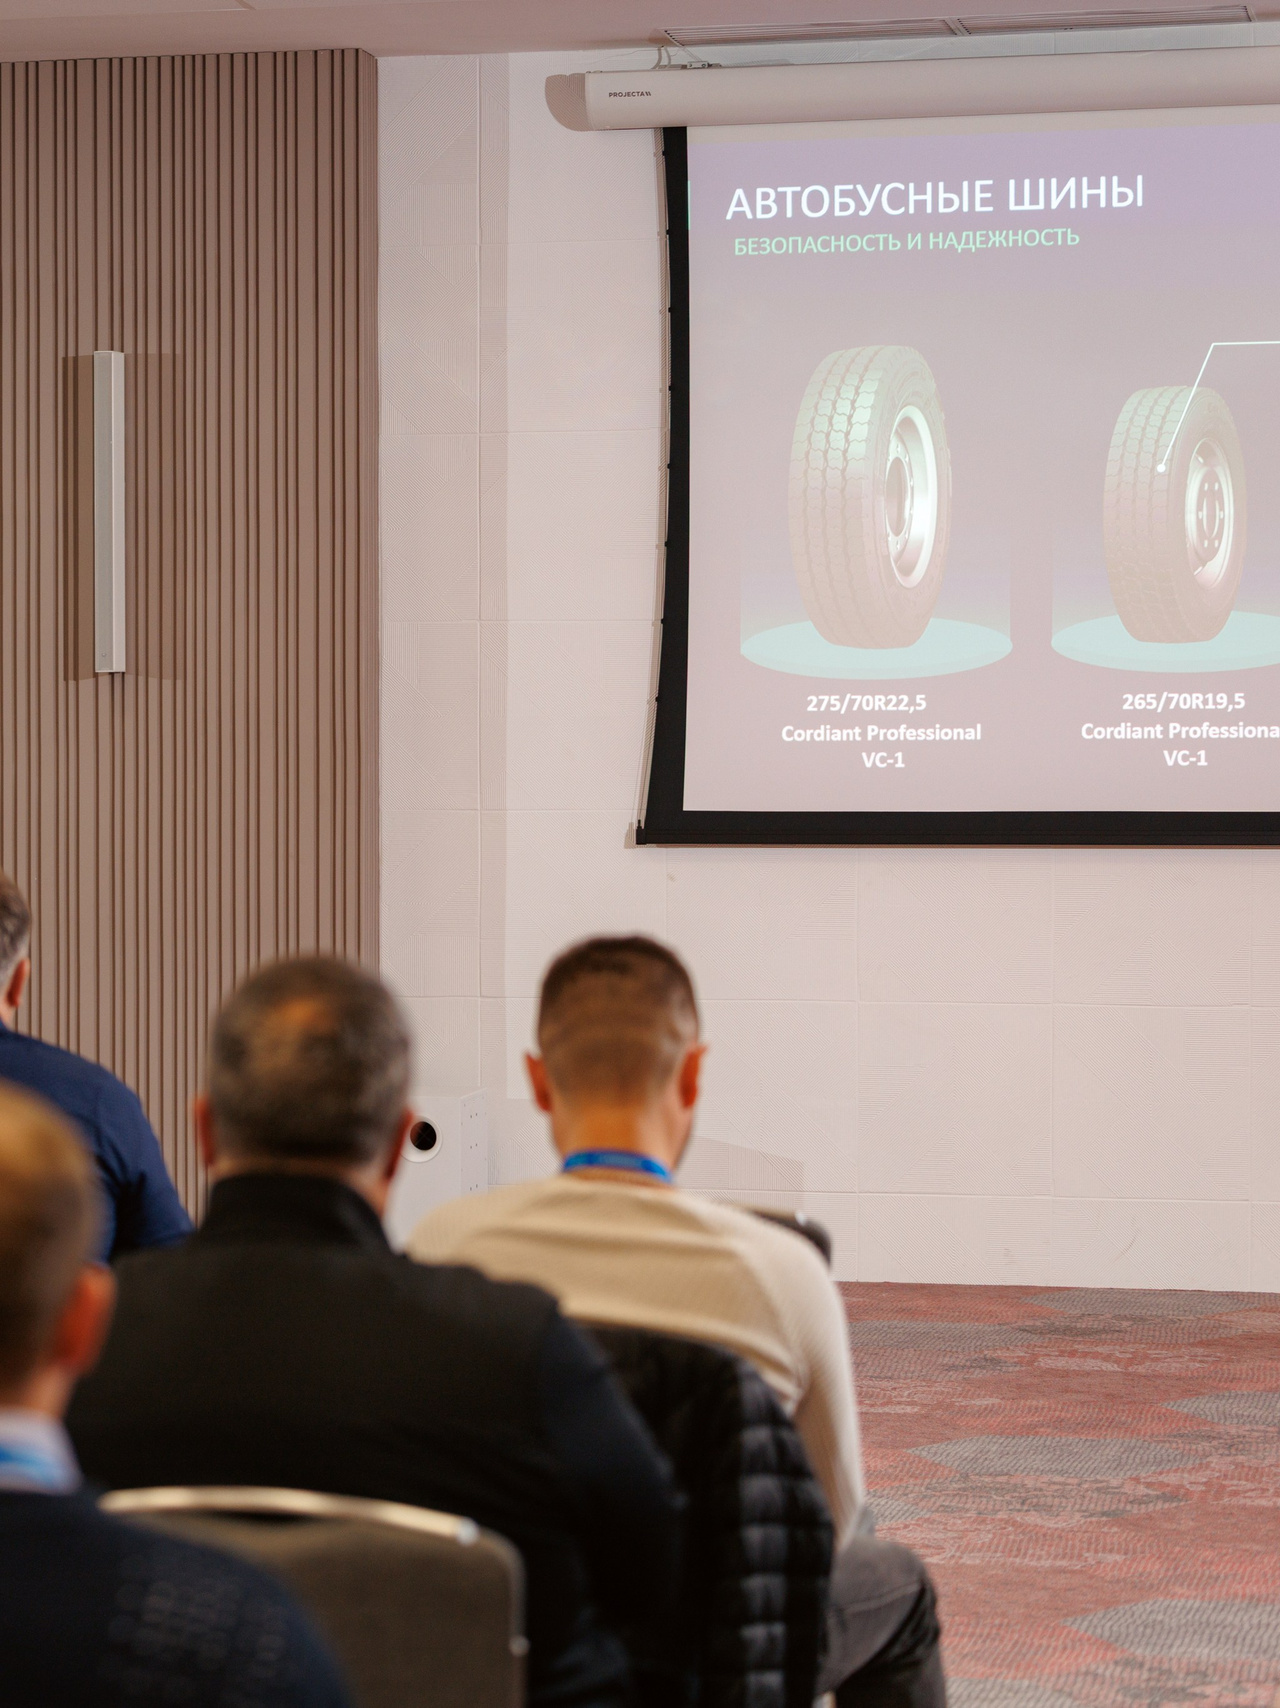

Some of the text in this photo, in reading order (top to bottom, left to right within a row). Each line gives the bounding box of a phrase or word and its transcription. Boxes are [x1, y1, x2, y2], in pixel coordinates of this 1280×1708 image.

[725, 175, 1143, 221] АВТОБУСНЫЕ ШИНЫ
[734, 228, 1080, 256] БЕЗОПАСНОСТЬ И НАДЕЖНОСТЬ
[806, 694, 927, 714] 275/70R22,5
[1122, 692, 1246, 713] 265/70R19,5
[781, 724, 982, 742] Cordiant Professional
[1081, 723, 1164, 740] Cordiant
[861, 752, 906, 768] VC-1
[1163, 750, 1209, 767] VC-1
